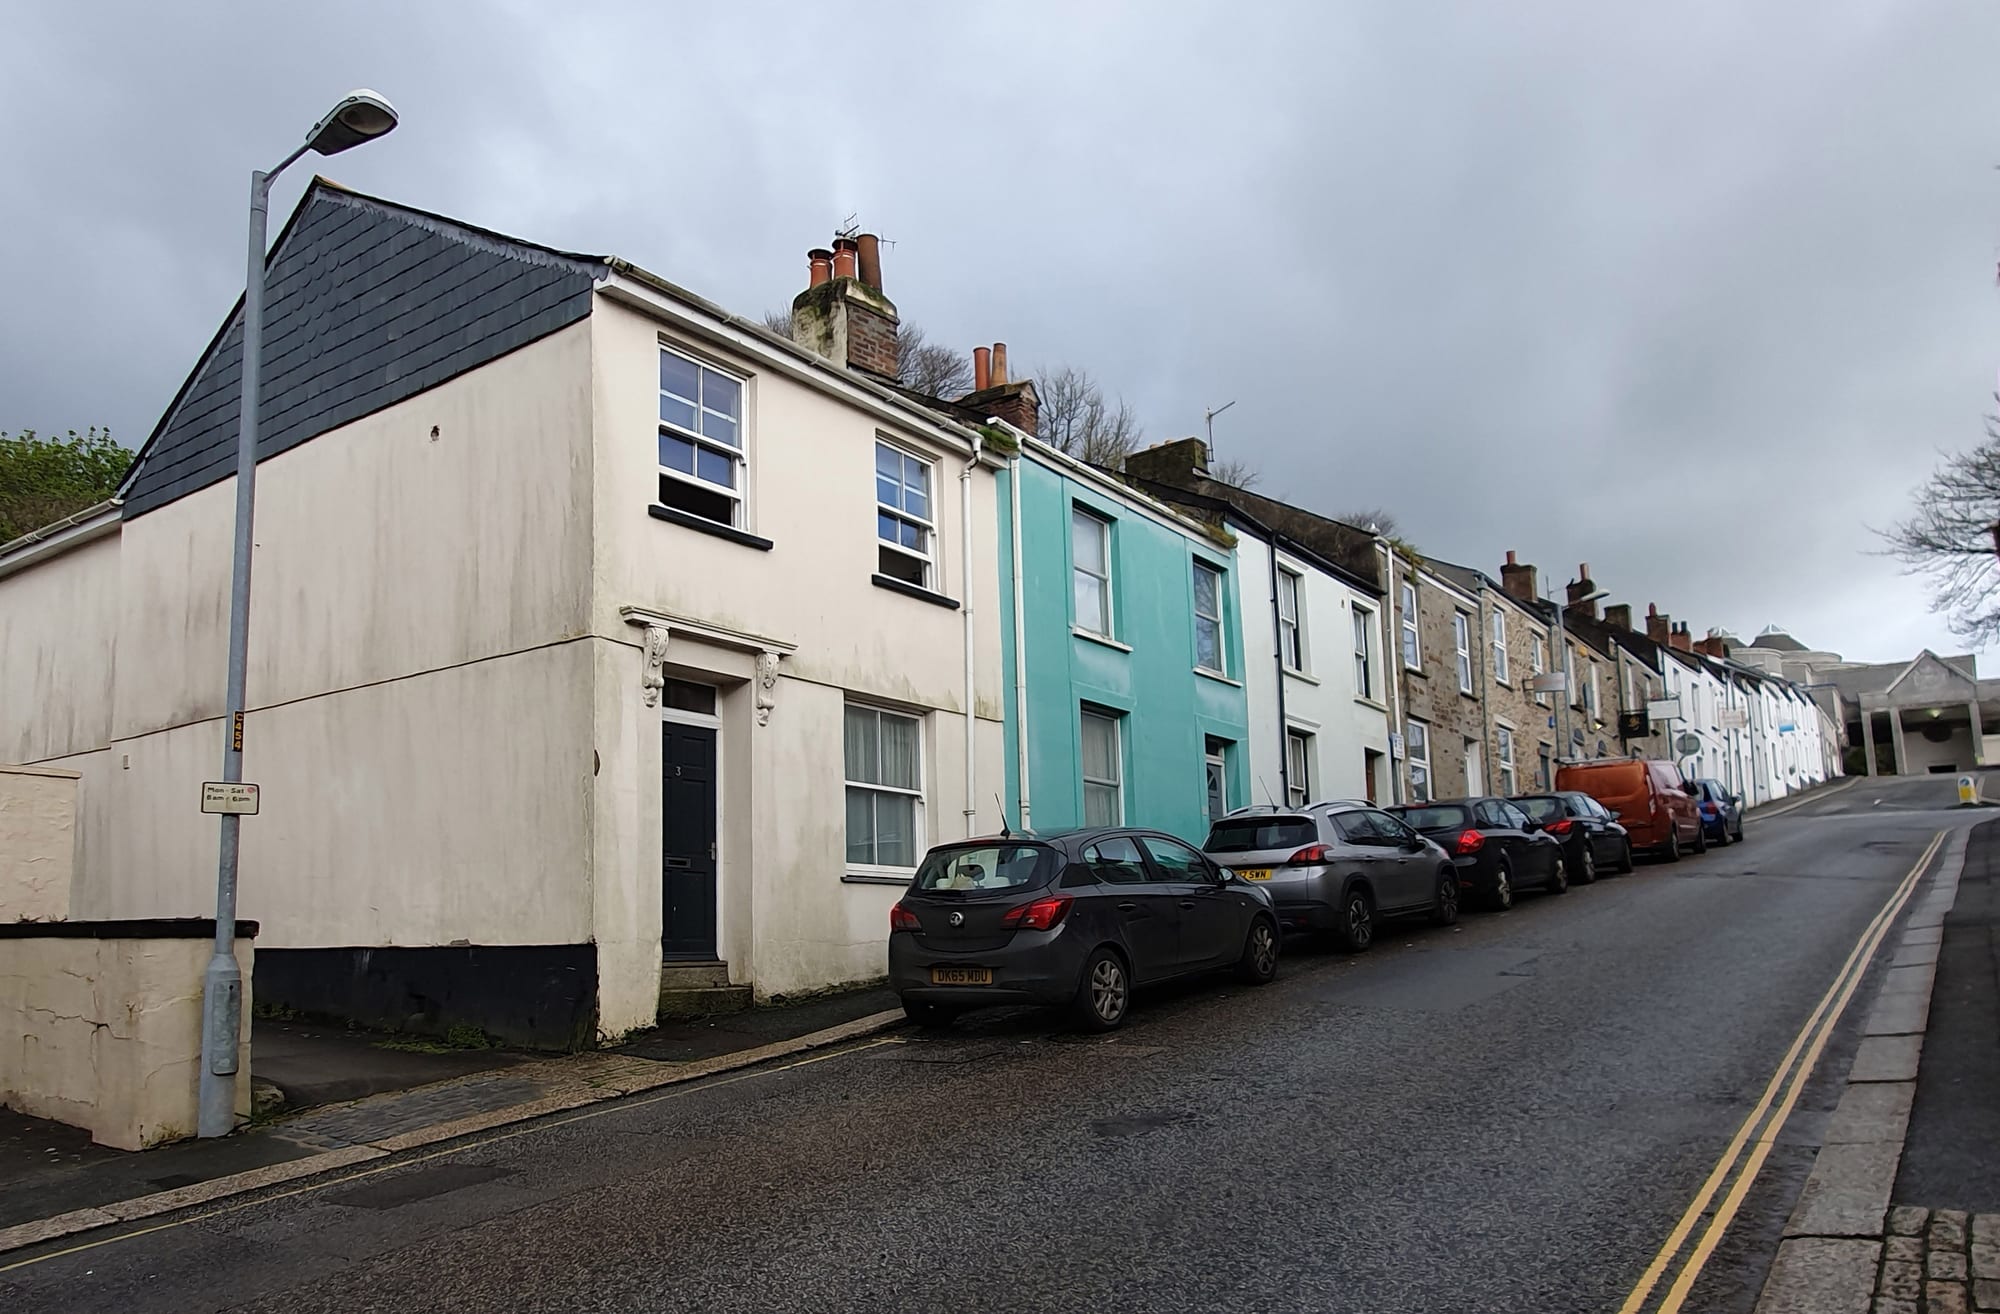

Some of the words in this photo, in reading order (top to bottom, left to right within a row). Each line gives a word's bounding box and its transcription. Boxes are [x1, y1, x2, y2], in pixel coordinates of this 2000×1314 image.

[235, 713, 243, 749] C454
[675, 766, 682, 776] 3
[938, 969, 965, 982] DK65
